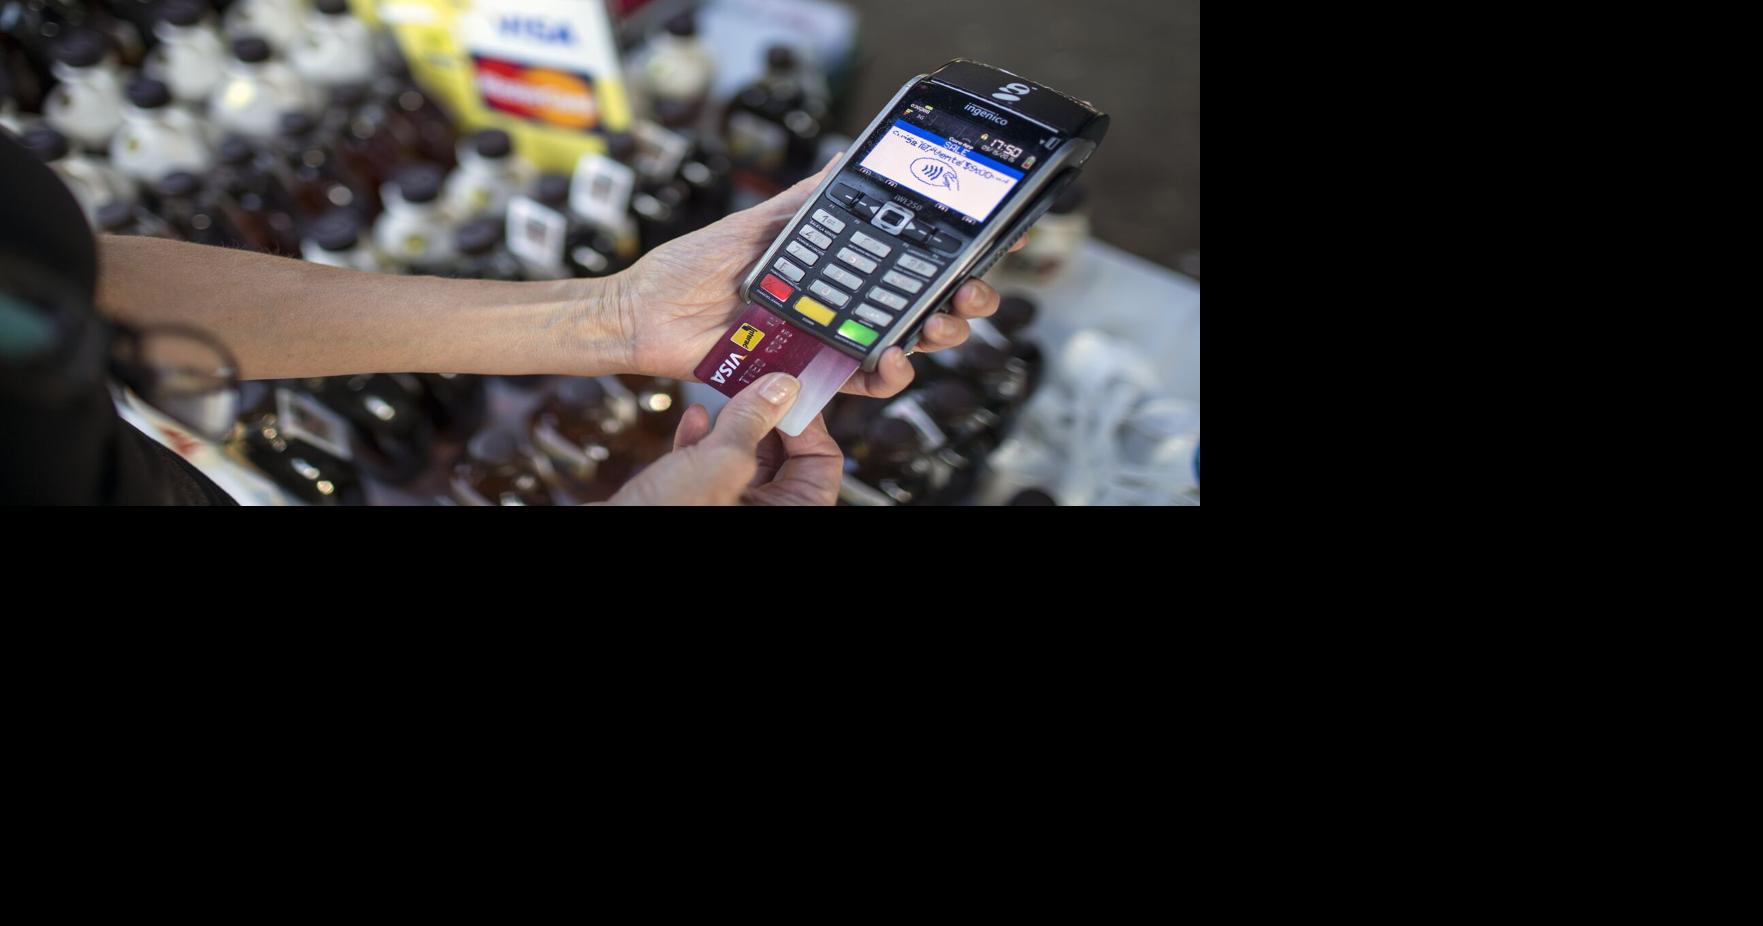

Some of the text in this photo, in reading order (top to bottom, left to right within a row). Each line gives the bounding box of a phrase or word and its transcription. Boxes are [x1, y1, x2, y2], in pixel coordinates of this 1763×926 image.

[963, 102, 1008, 127] ingenico
[944, 141, 970, 156] SALE
[990, 139, 1023, 158] 17:50
[710, 352, 747, 385] VISA
